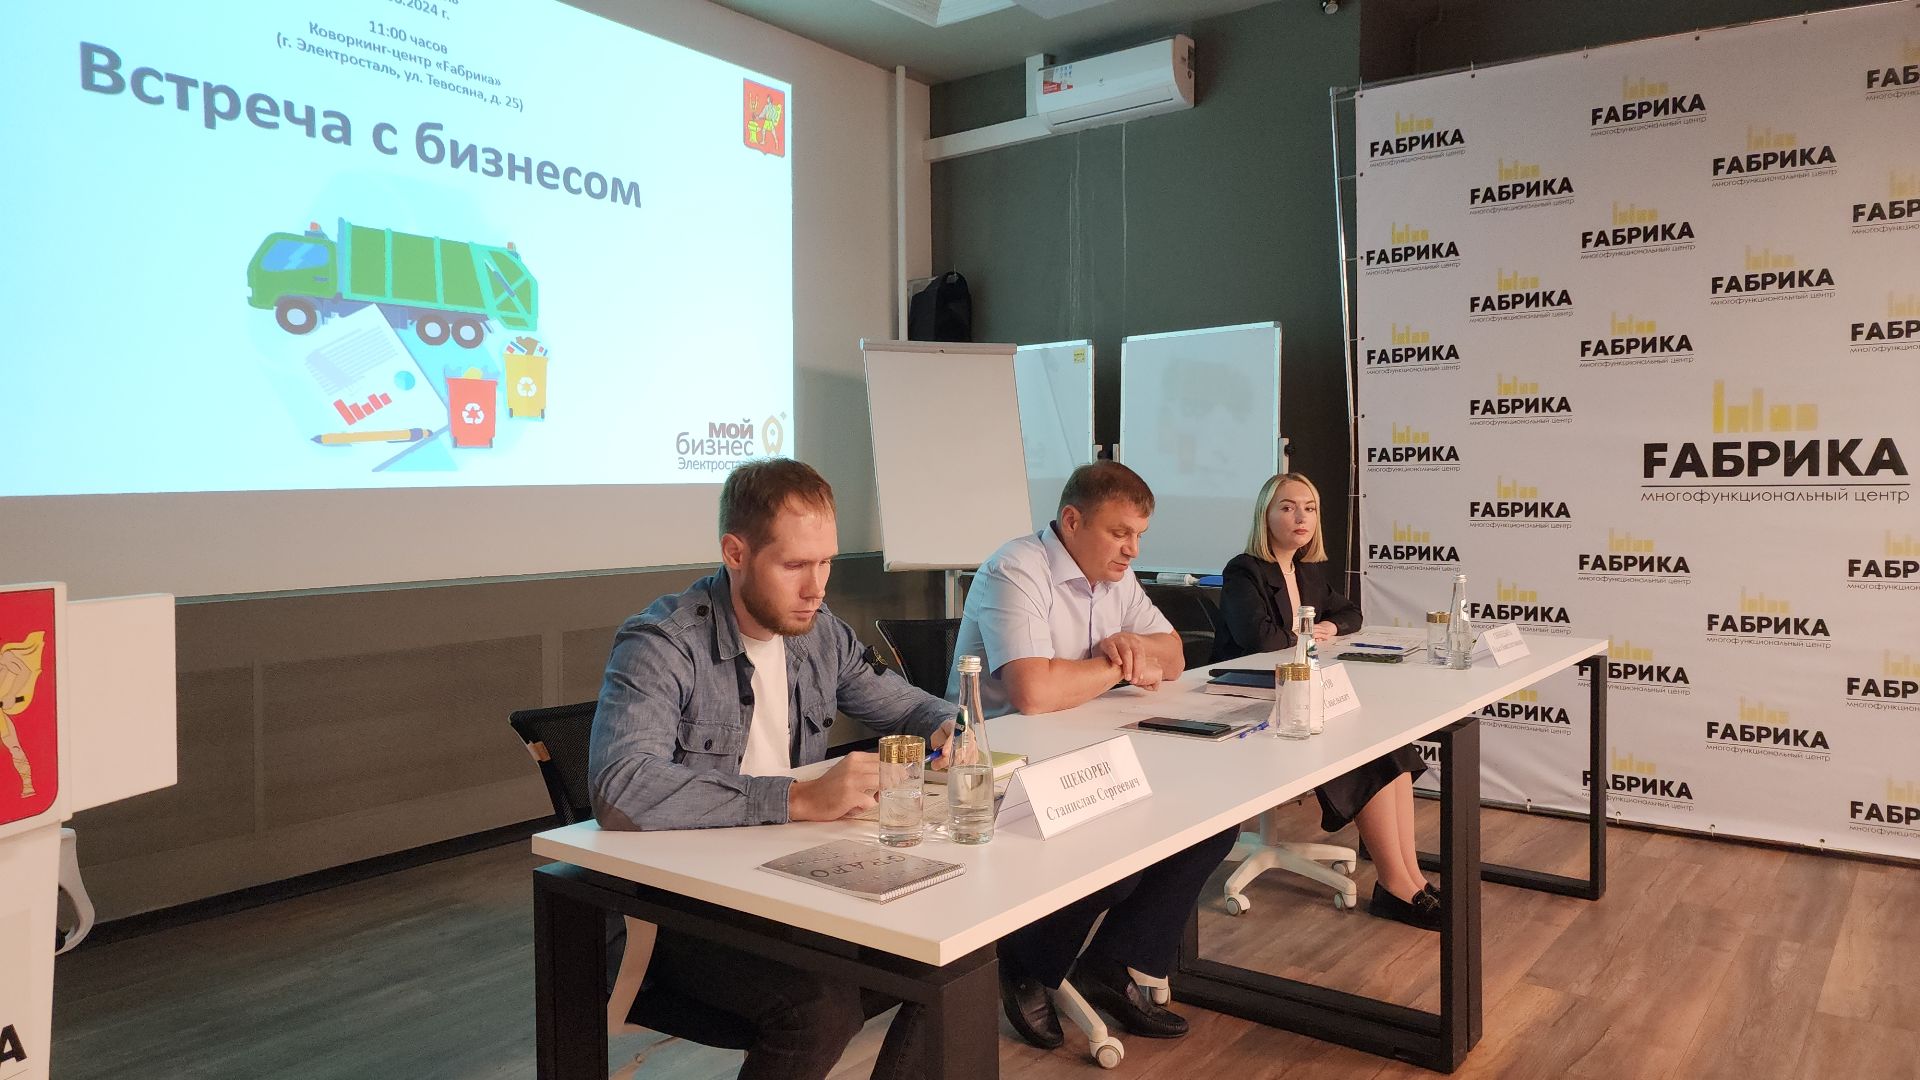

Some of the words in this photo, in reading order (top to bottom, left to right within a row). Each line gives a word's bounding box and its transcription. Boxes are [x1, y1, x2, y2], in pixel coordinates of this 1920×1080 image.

[387, 0, 437, 16] .2024
[309, 21, 432, 68] Коворкинг-центр
[369, 21, 406, 42] 11:00
[410, 35, 448, 54] часов
[277, 32, 292, 48] (г.
[297, 37, 400, 78] Электросталь,
[404, 70, 423, 84] ул.
[427, 73, 487, 102] Тевосяна,
[491, 96, 502, 106] д.
[505, 95, 524, 112] 25)
[79, 40, 352, 148] Встреча
[372, 122, 398, 156] с
[415, 122, 642, 209] бизнесом
[676, 431, 754, 456] бизнес
[708, 418, 754, 440] мой
[1641, 490, 1848, 504] многофункциональный
[1854, 488, 1910, 504] центр
[1046, 794, 1097, 821] Станислав
[1097, 777, 1141, 800] Сергеевич
